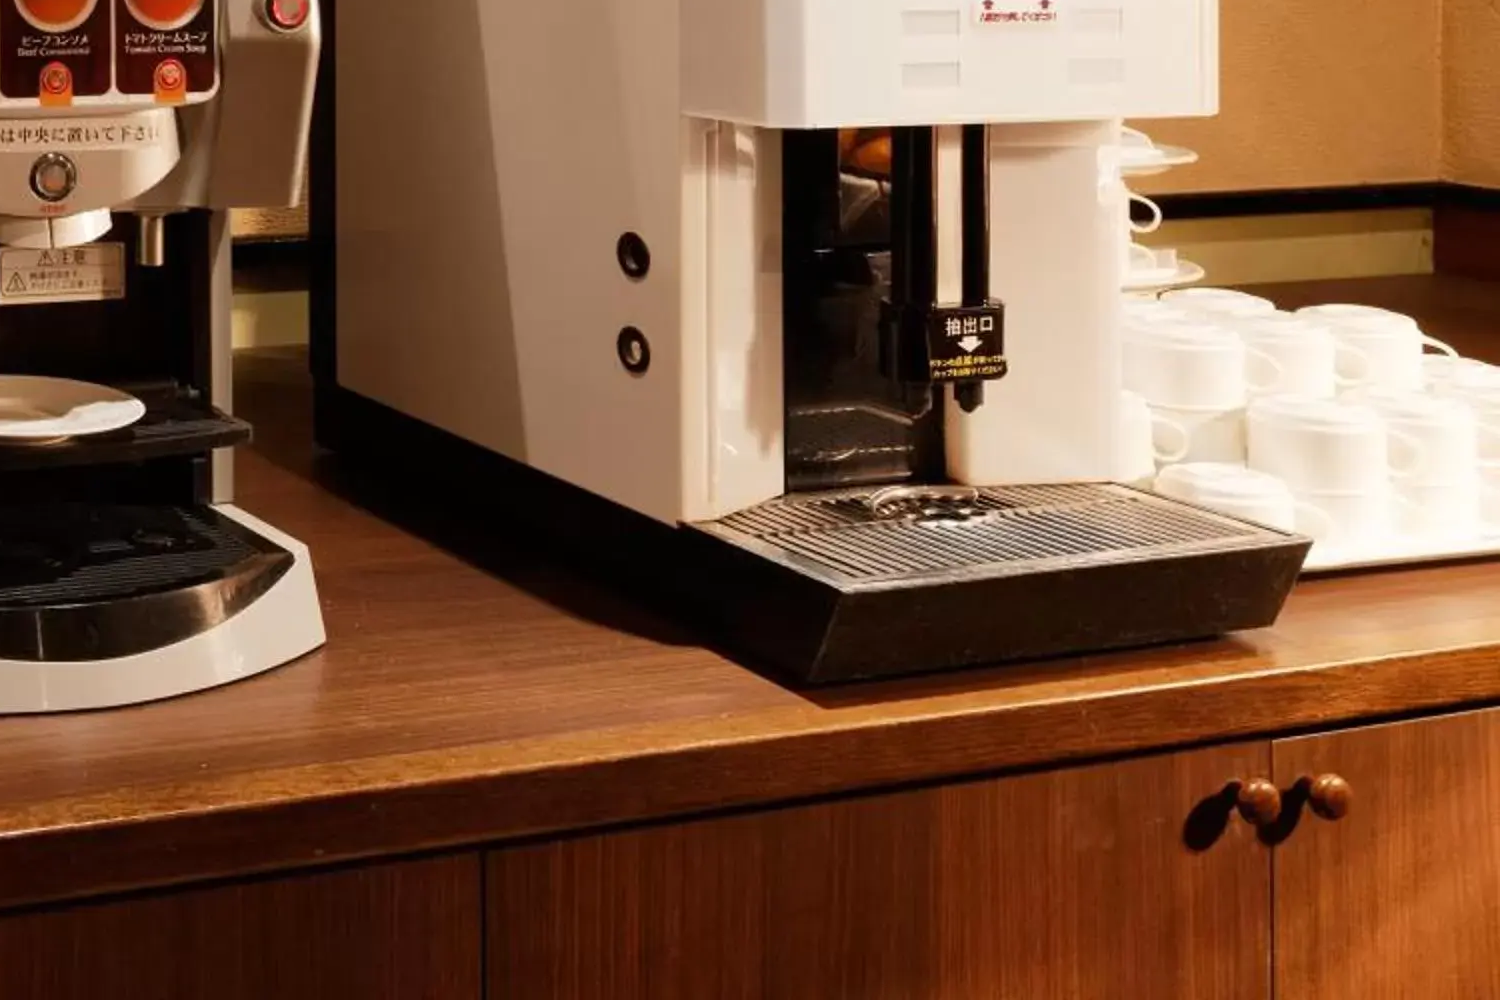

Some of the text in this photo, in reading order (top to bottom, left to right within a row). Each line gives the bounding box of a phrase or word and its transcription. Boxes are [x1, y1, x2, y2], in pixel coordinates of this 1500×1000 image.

[21, 33, 89, 47] ビーフコンソメ
[124, 31, 208, 45] トマトクリームスープ
[945, 315, 994, 337] 抽出口
